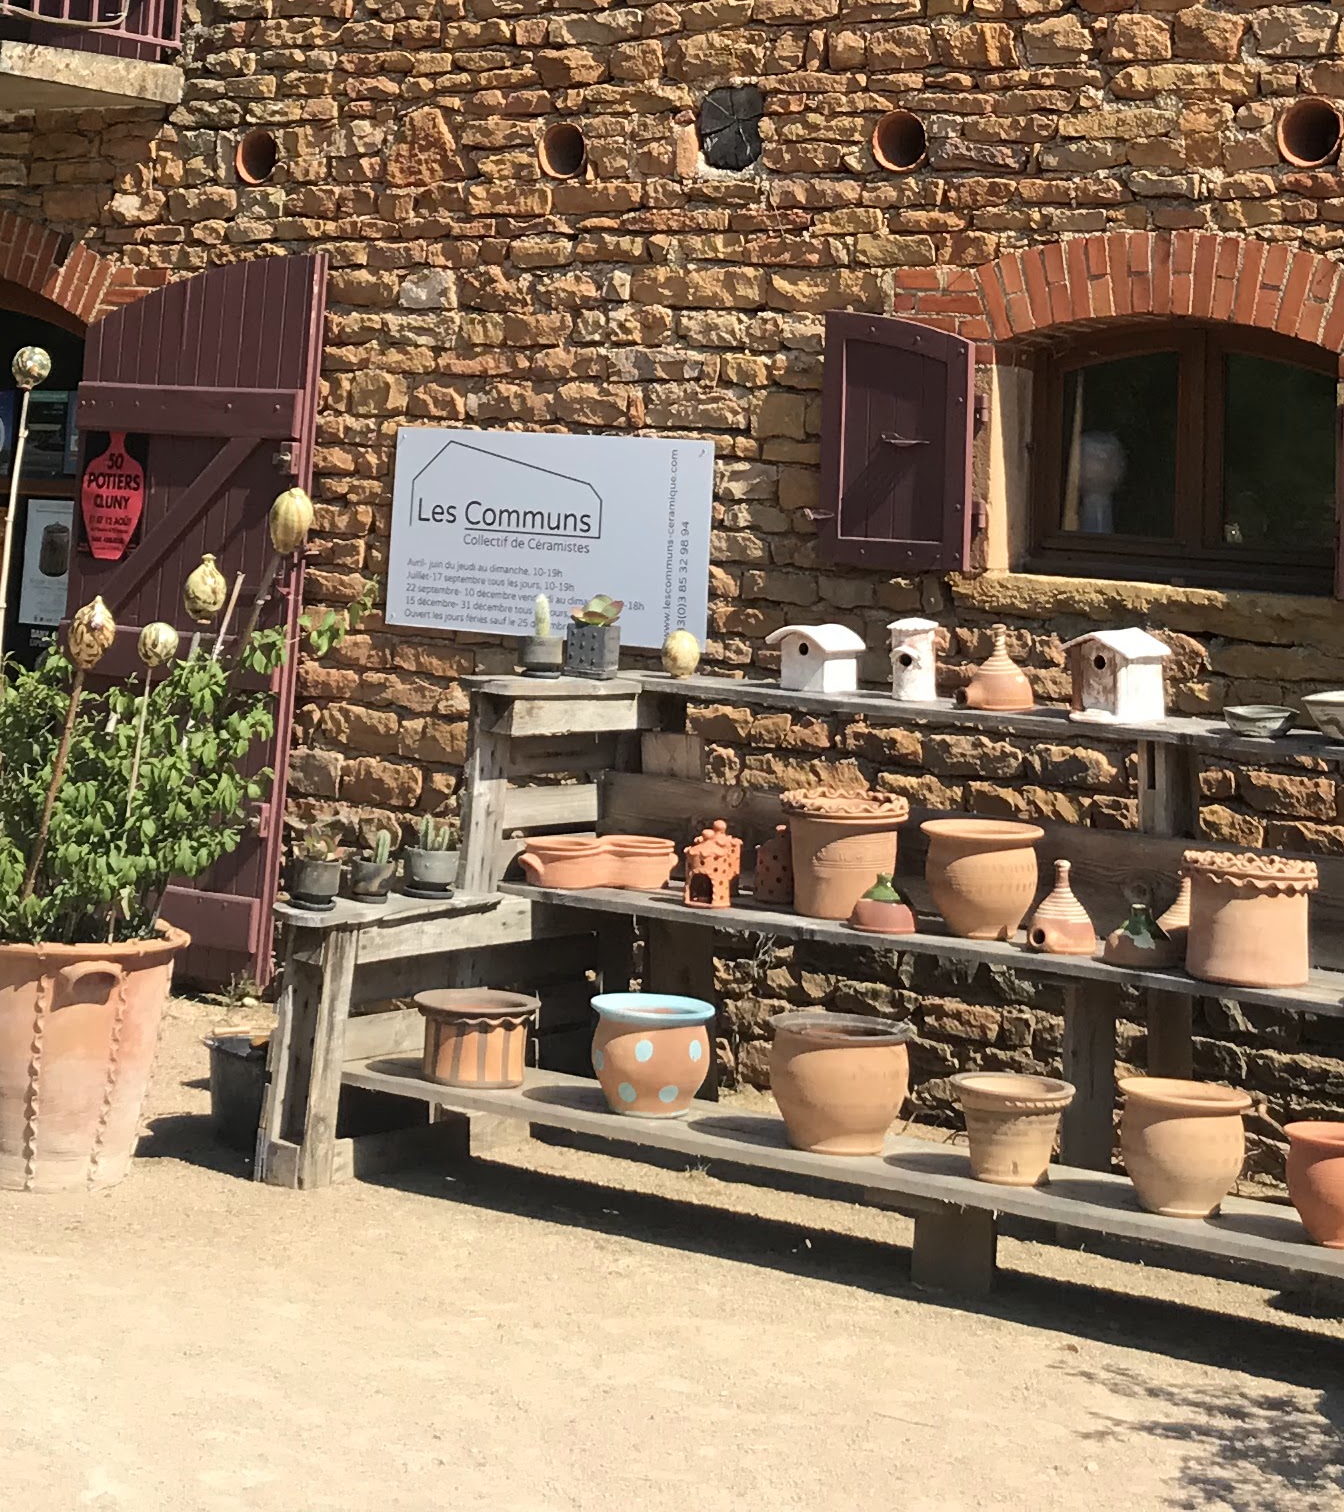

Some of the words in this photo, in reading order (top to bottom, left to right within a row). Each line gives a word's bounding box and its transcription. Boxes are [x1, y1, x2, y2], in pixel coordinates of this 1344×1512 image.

[107, 453, 124, 470] 50
[87, 472, 140, 492] POTIERS
[94, 494, 130, 510] CLUNY
[418, 497, 457, 524] Les
[464, 500, 592, 533] Communs
[680, 521, 690, 537] 94
[463, 533, 508, 547] Collectif
[510, 536, 525, 549] de
[527, 538, 591, 554] Céramistes
[679, 539, 689, 555] 98
[445, 560, 455, 569] du
[678, 558, 688, 574] 32
[507, 578, 518, 588] les
[678, 576, 688, 593] 85
[464, 587, 475, 597] 10
[555, 596, 566, 604] au
[460, 600, 471, 610] 31
